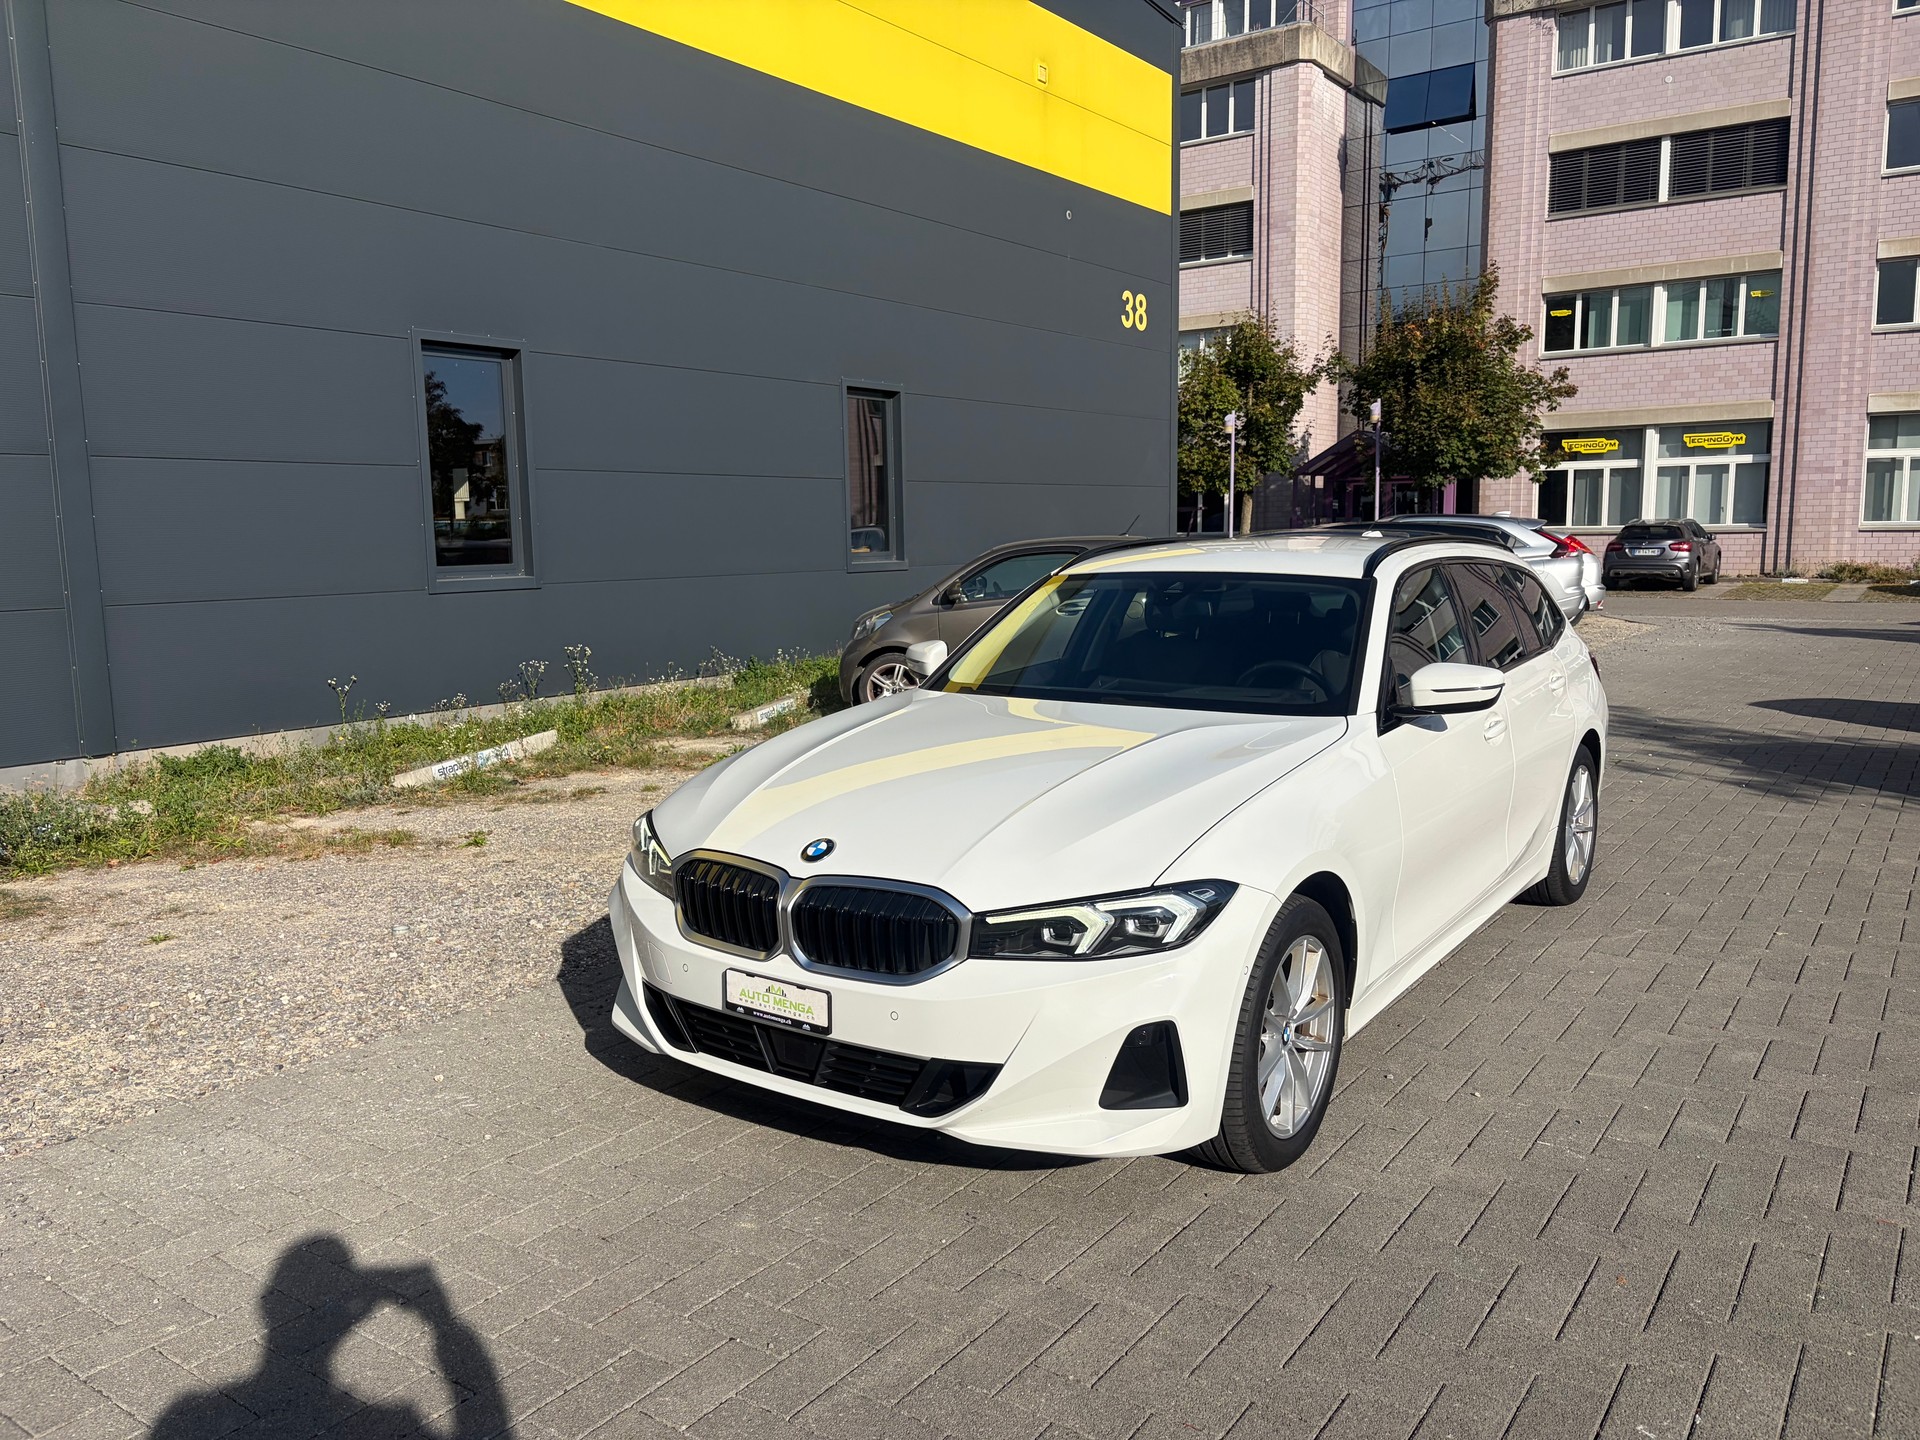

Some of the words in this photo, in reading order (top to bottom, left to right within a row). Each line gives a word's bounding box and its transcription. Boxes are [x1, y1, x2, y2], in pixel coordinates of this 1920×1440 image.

[1121, 290, 1147, 331] 38
[739, 988, 770, 1003] AUTO
[773, 996, 814, 1015] MENGA
